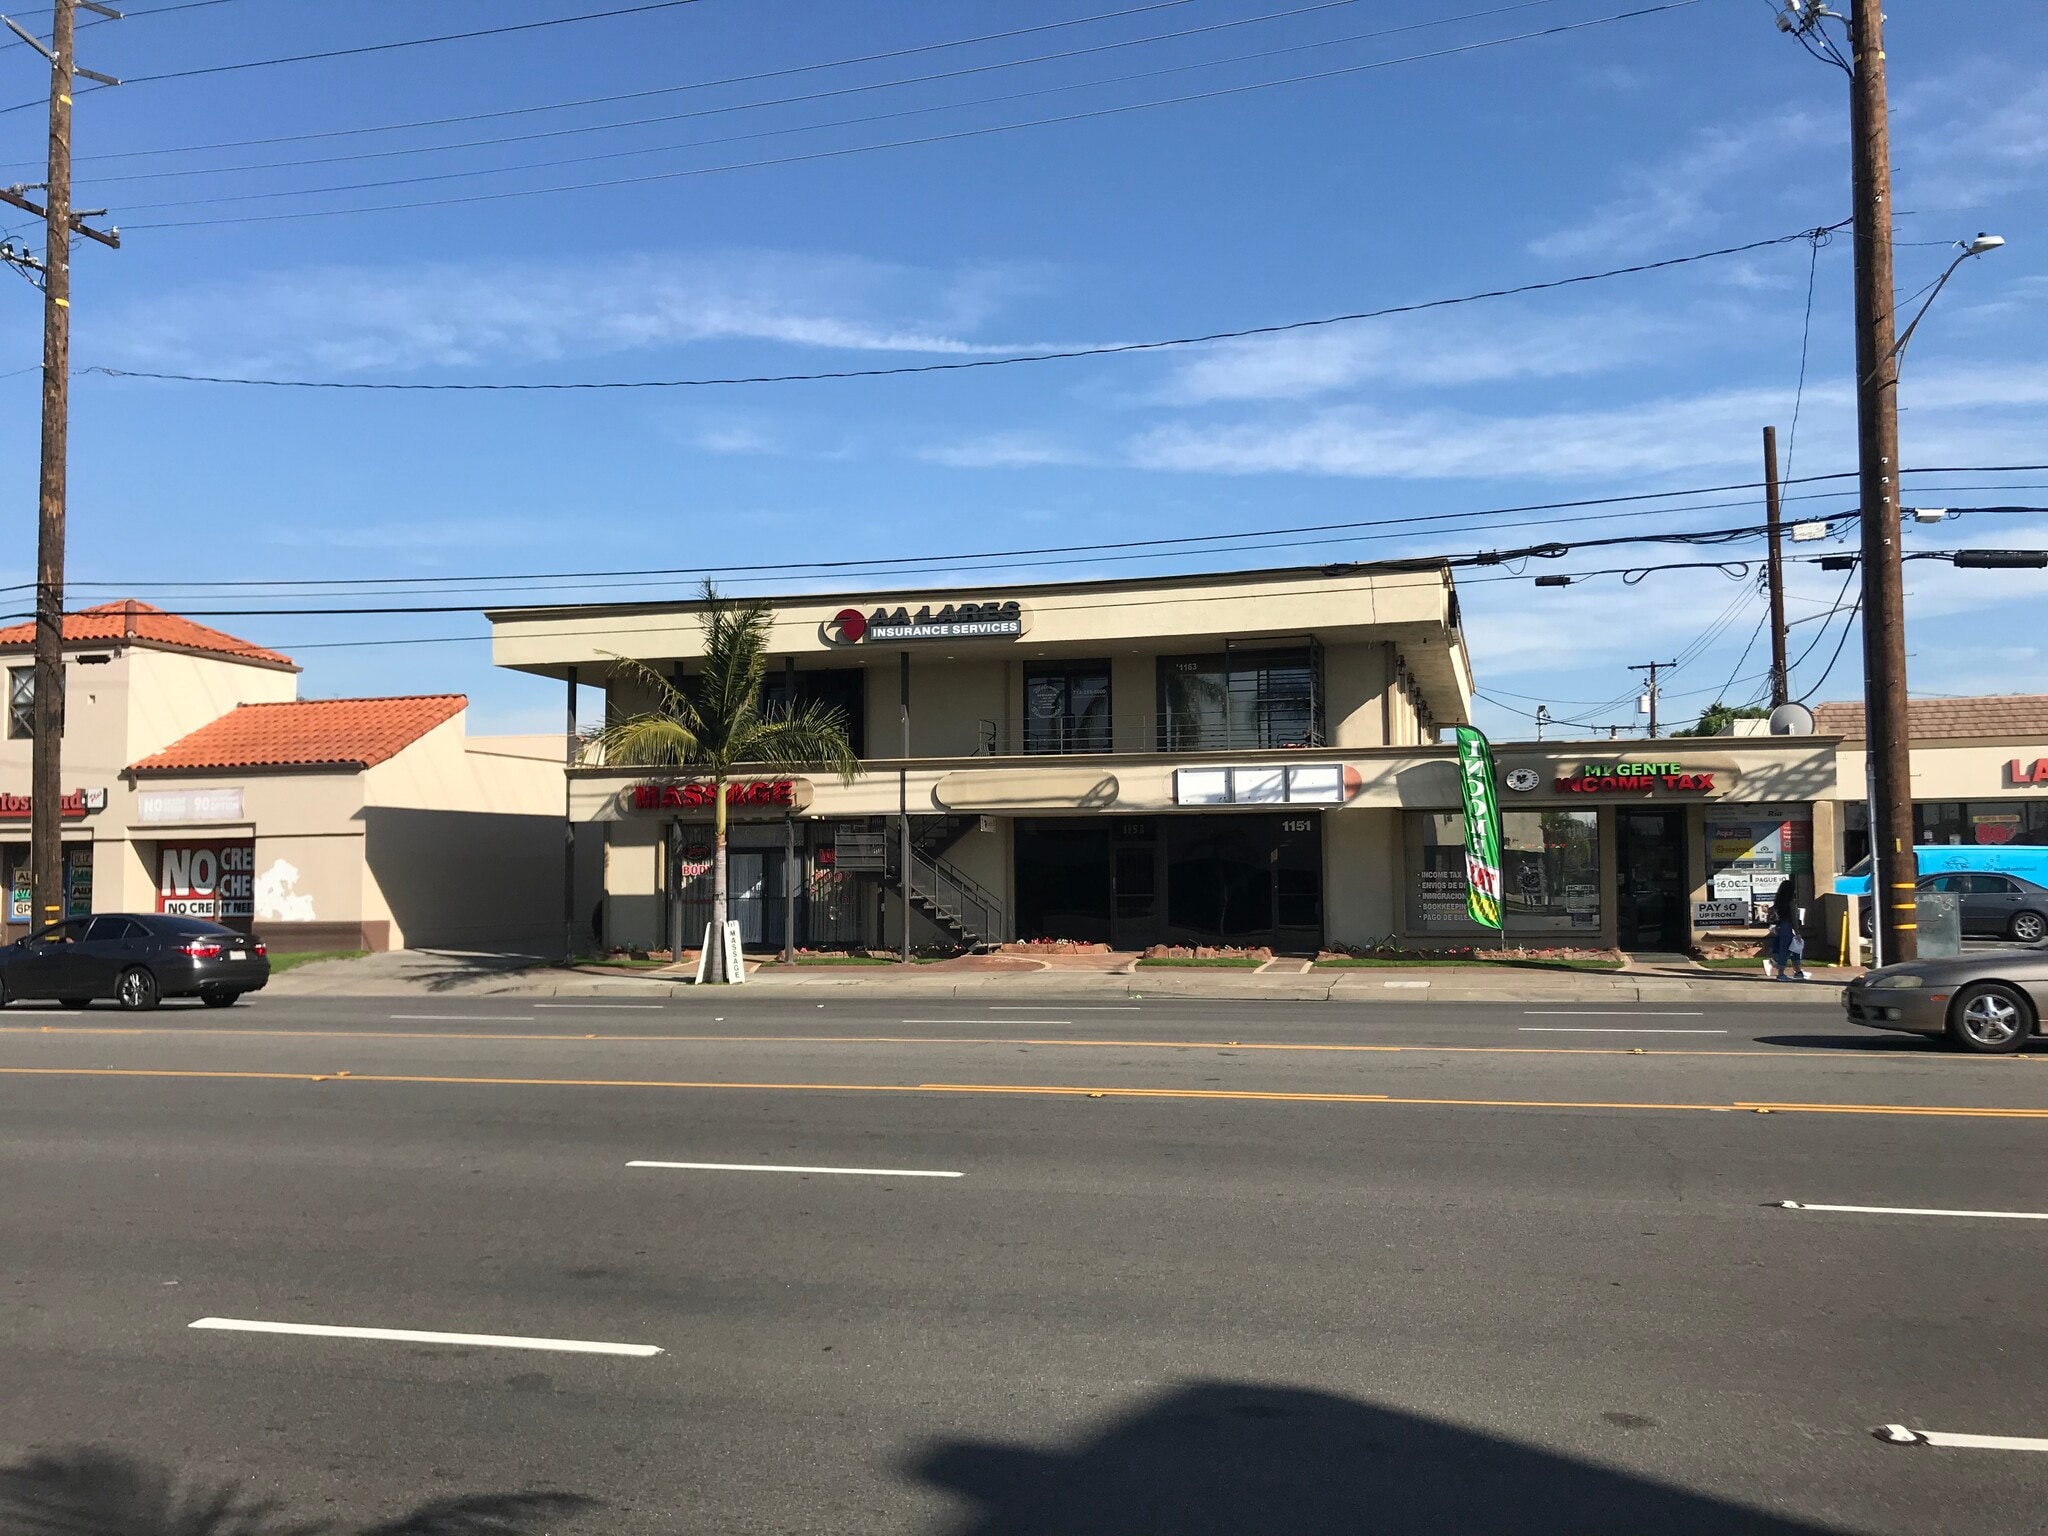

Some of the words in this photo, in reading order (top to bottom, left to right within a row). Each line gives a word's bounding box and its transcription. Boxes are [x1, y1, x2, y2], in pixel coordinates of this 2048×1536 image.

[869, 607, 911, 626] AA
[914, 601, 1021, 626] LARES
[873, 625, 948, 637] INSURANCE
[953, 622, 1018, 634] SERVICES
[1585, 764, 1610, 776] MI
[1616, 762, 1681, 776] GENTE
[1555, 775, 1655, 793] INCOME
[1663, 774, 1715, 790] TAX
[635, 782, 793, 809] MASSAGE
[1282, 820, 1311, 831] 1151
[161, 849, 217, 897] NO
[221, 847, 252, 871] CRE
[682, 865, 713, 875] BODY
[168, 903, 187, 914] NO
[730, 930, 740, 979] MASSAGE
